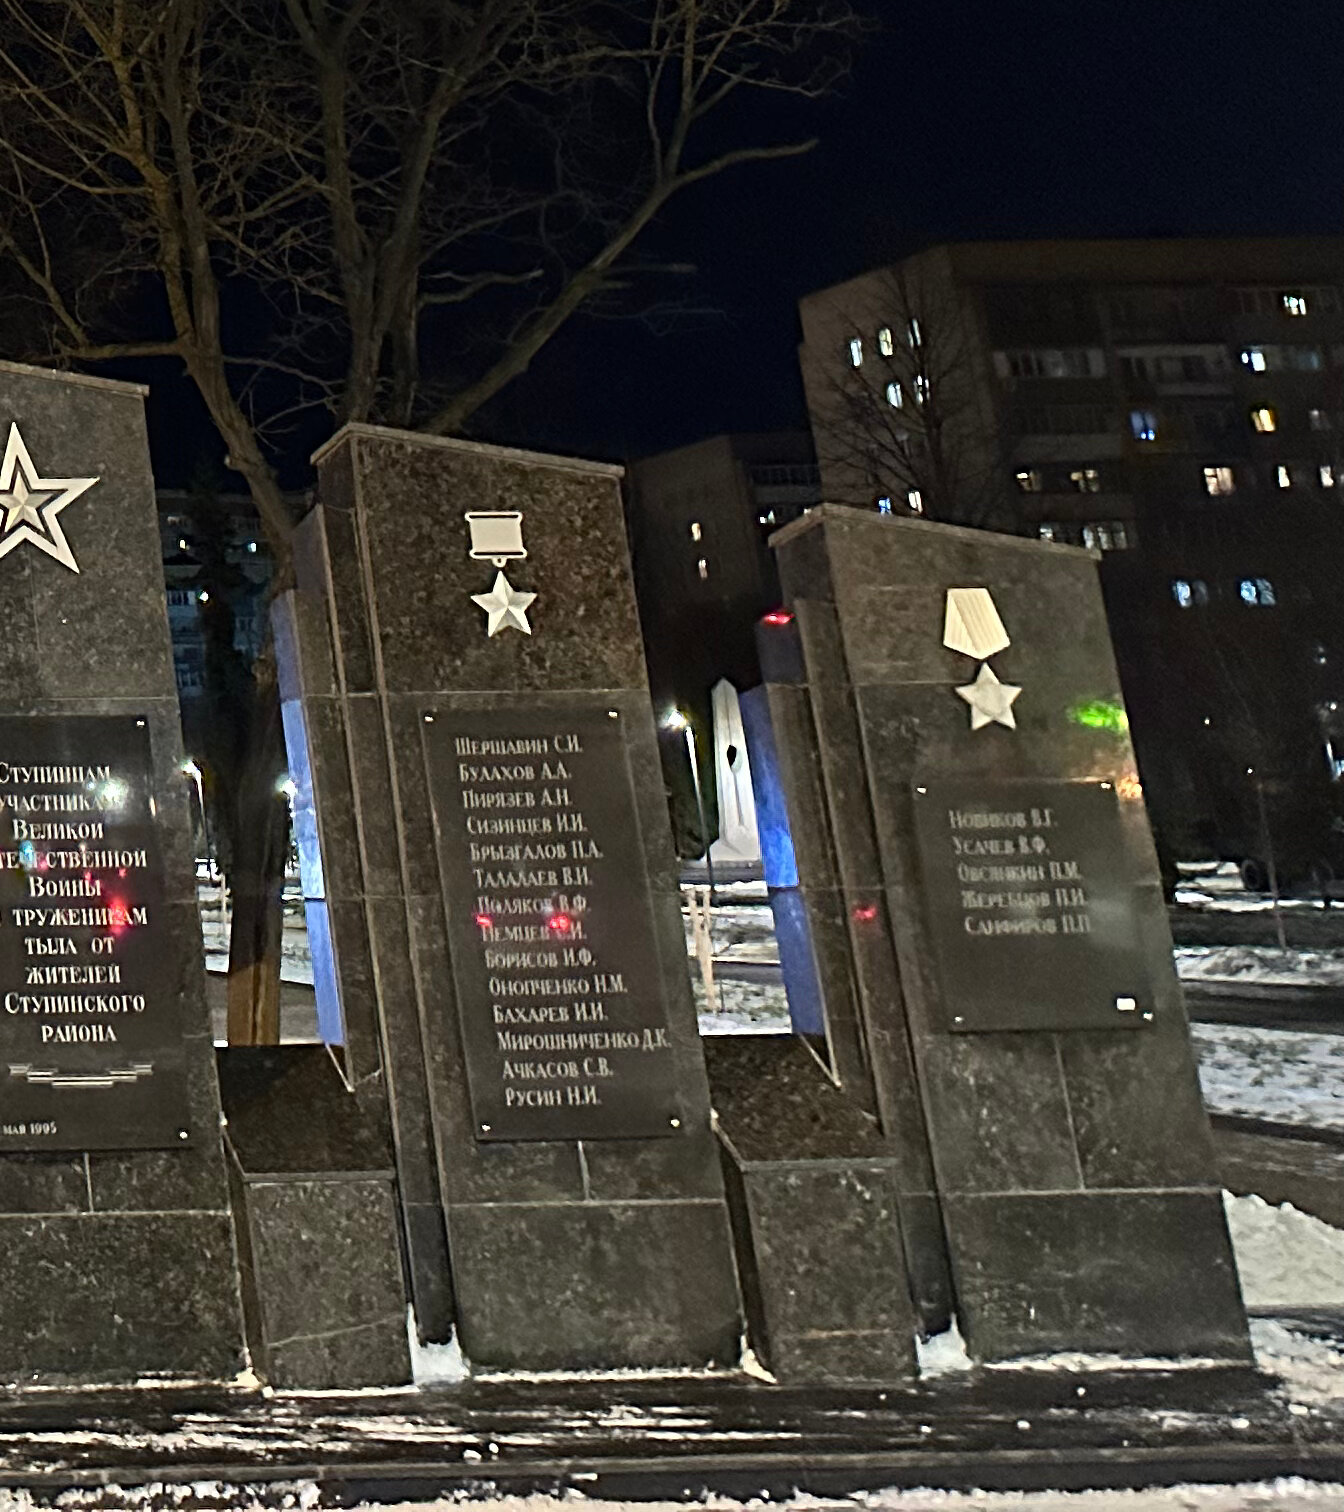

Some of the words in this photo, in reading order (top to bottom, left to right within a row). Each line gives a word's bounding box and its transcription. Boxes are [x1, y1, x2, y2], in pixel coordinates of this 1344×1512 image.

[24, 937, 78, 955] ТЫЛА
[90, 936, 115, 954] ОТ
[25, 963, 121, 984] ЖИТЕЛЕЙ
[4, 991, 146, 1014] СТУПИНСКОГО
[41, 1022, 118, 1043] РАЙОНА
